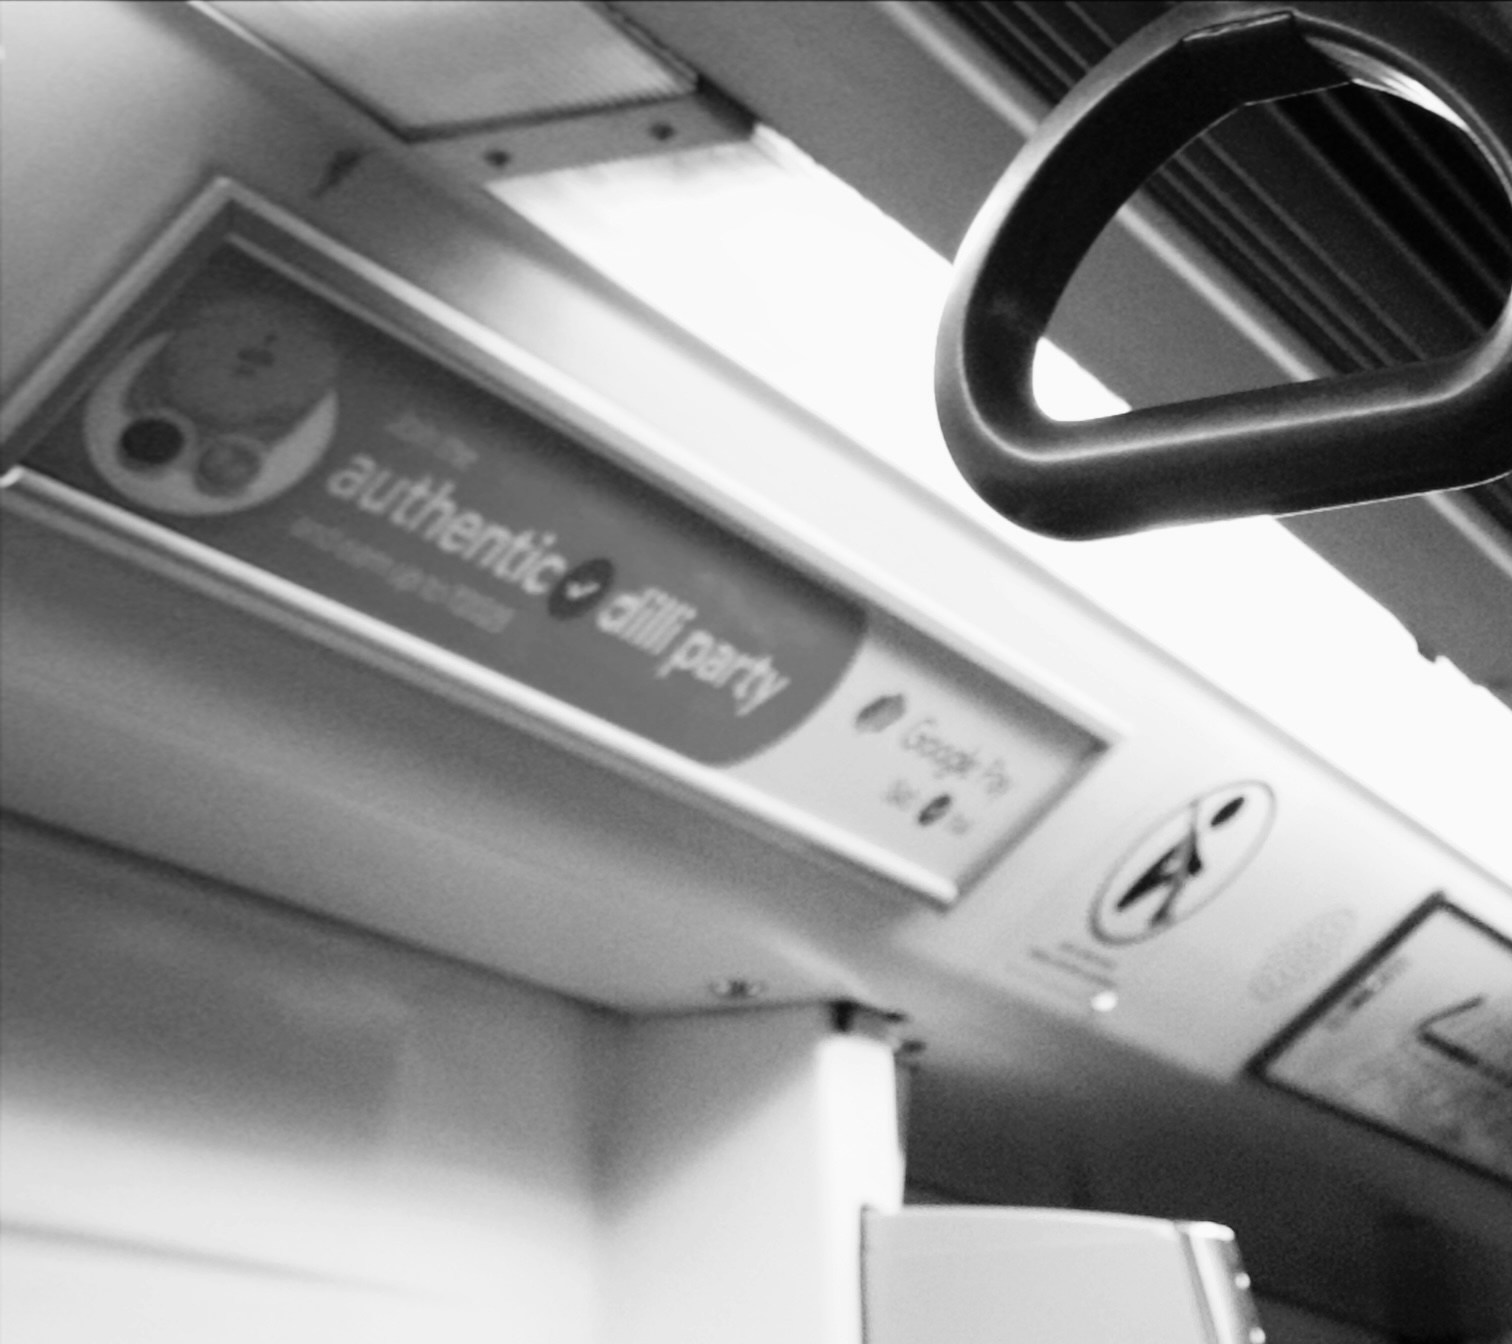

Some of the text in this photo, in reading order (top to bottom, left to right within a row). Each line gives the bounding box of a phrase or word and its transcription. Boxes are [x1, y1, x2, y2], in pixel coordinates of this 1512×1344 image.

[326, 452, 568, 594] authentic
[596, 586, 698, 657] dilli
[653, 628, 792, 717] party
[900, 717, 979, 779] Google
